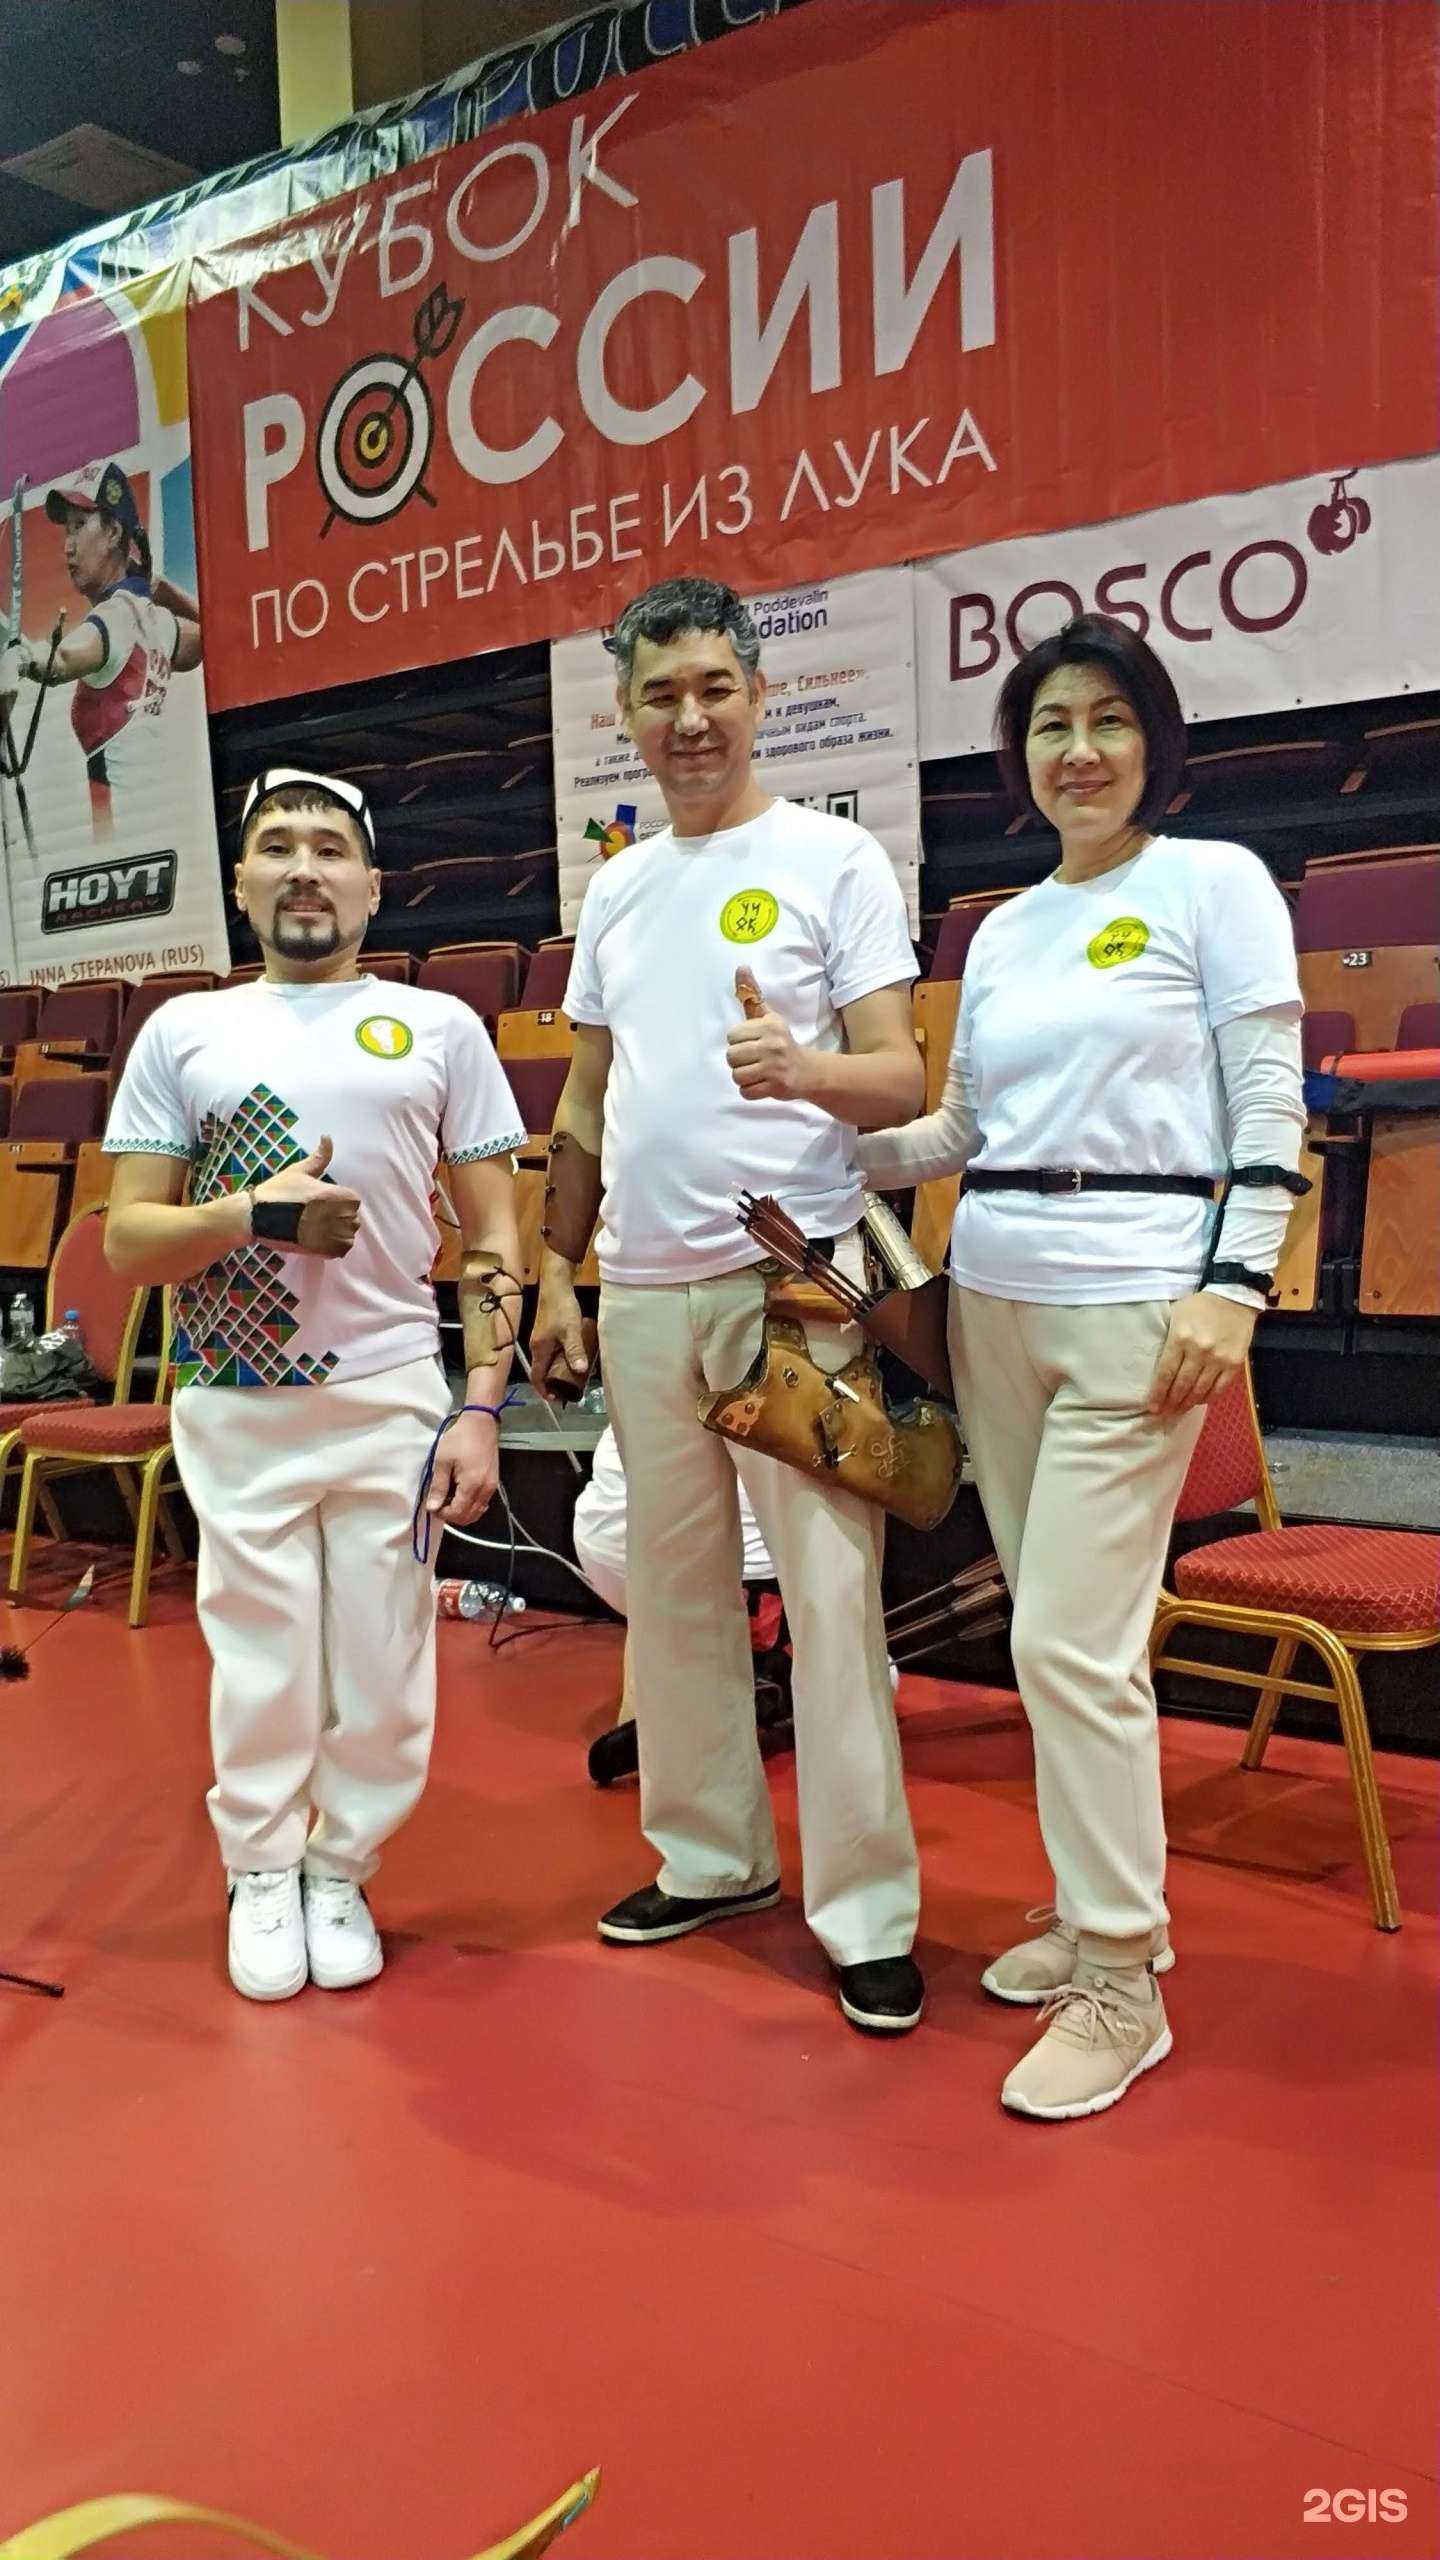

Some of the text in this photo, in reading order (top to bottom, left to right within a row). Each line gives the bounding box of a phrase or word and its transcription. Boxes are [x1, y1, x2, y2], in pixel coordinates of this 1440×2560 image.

[236, 92, 640, 352] КУБОК
[243, 148, 996, 552] РОССИИ
[250, 407, 998, 648] ПО СТРЕЛЬБЕ ИЗ ЛУКА
[758, 608, 828, 639] dation
[949, 541, 1308, 682] BOSCO
[49, 861, 170, 913] HOYT
[71, 951, 156, 979] STEPANOVA
[161, 943, 205, 971] (RUS)
